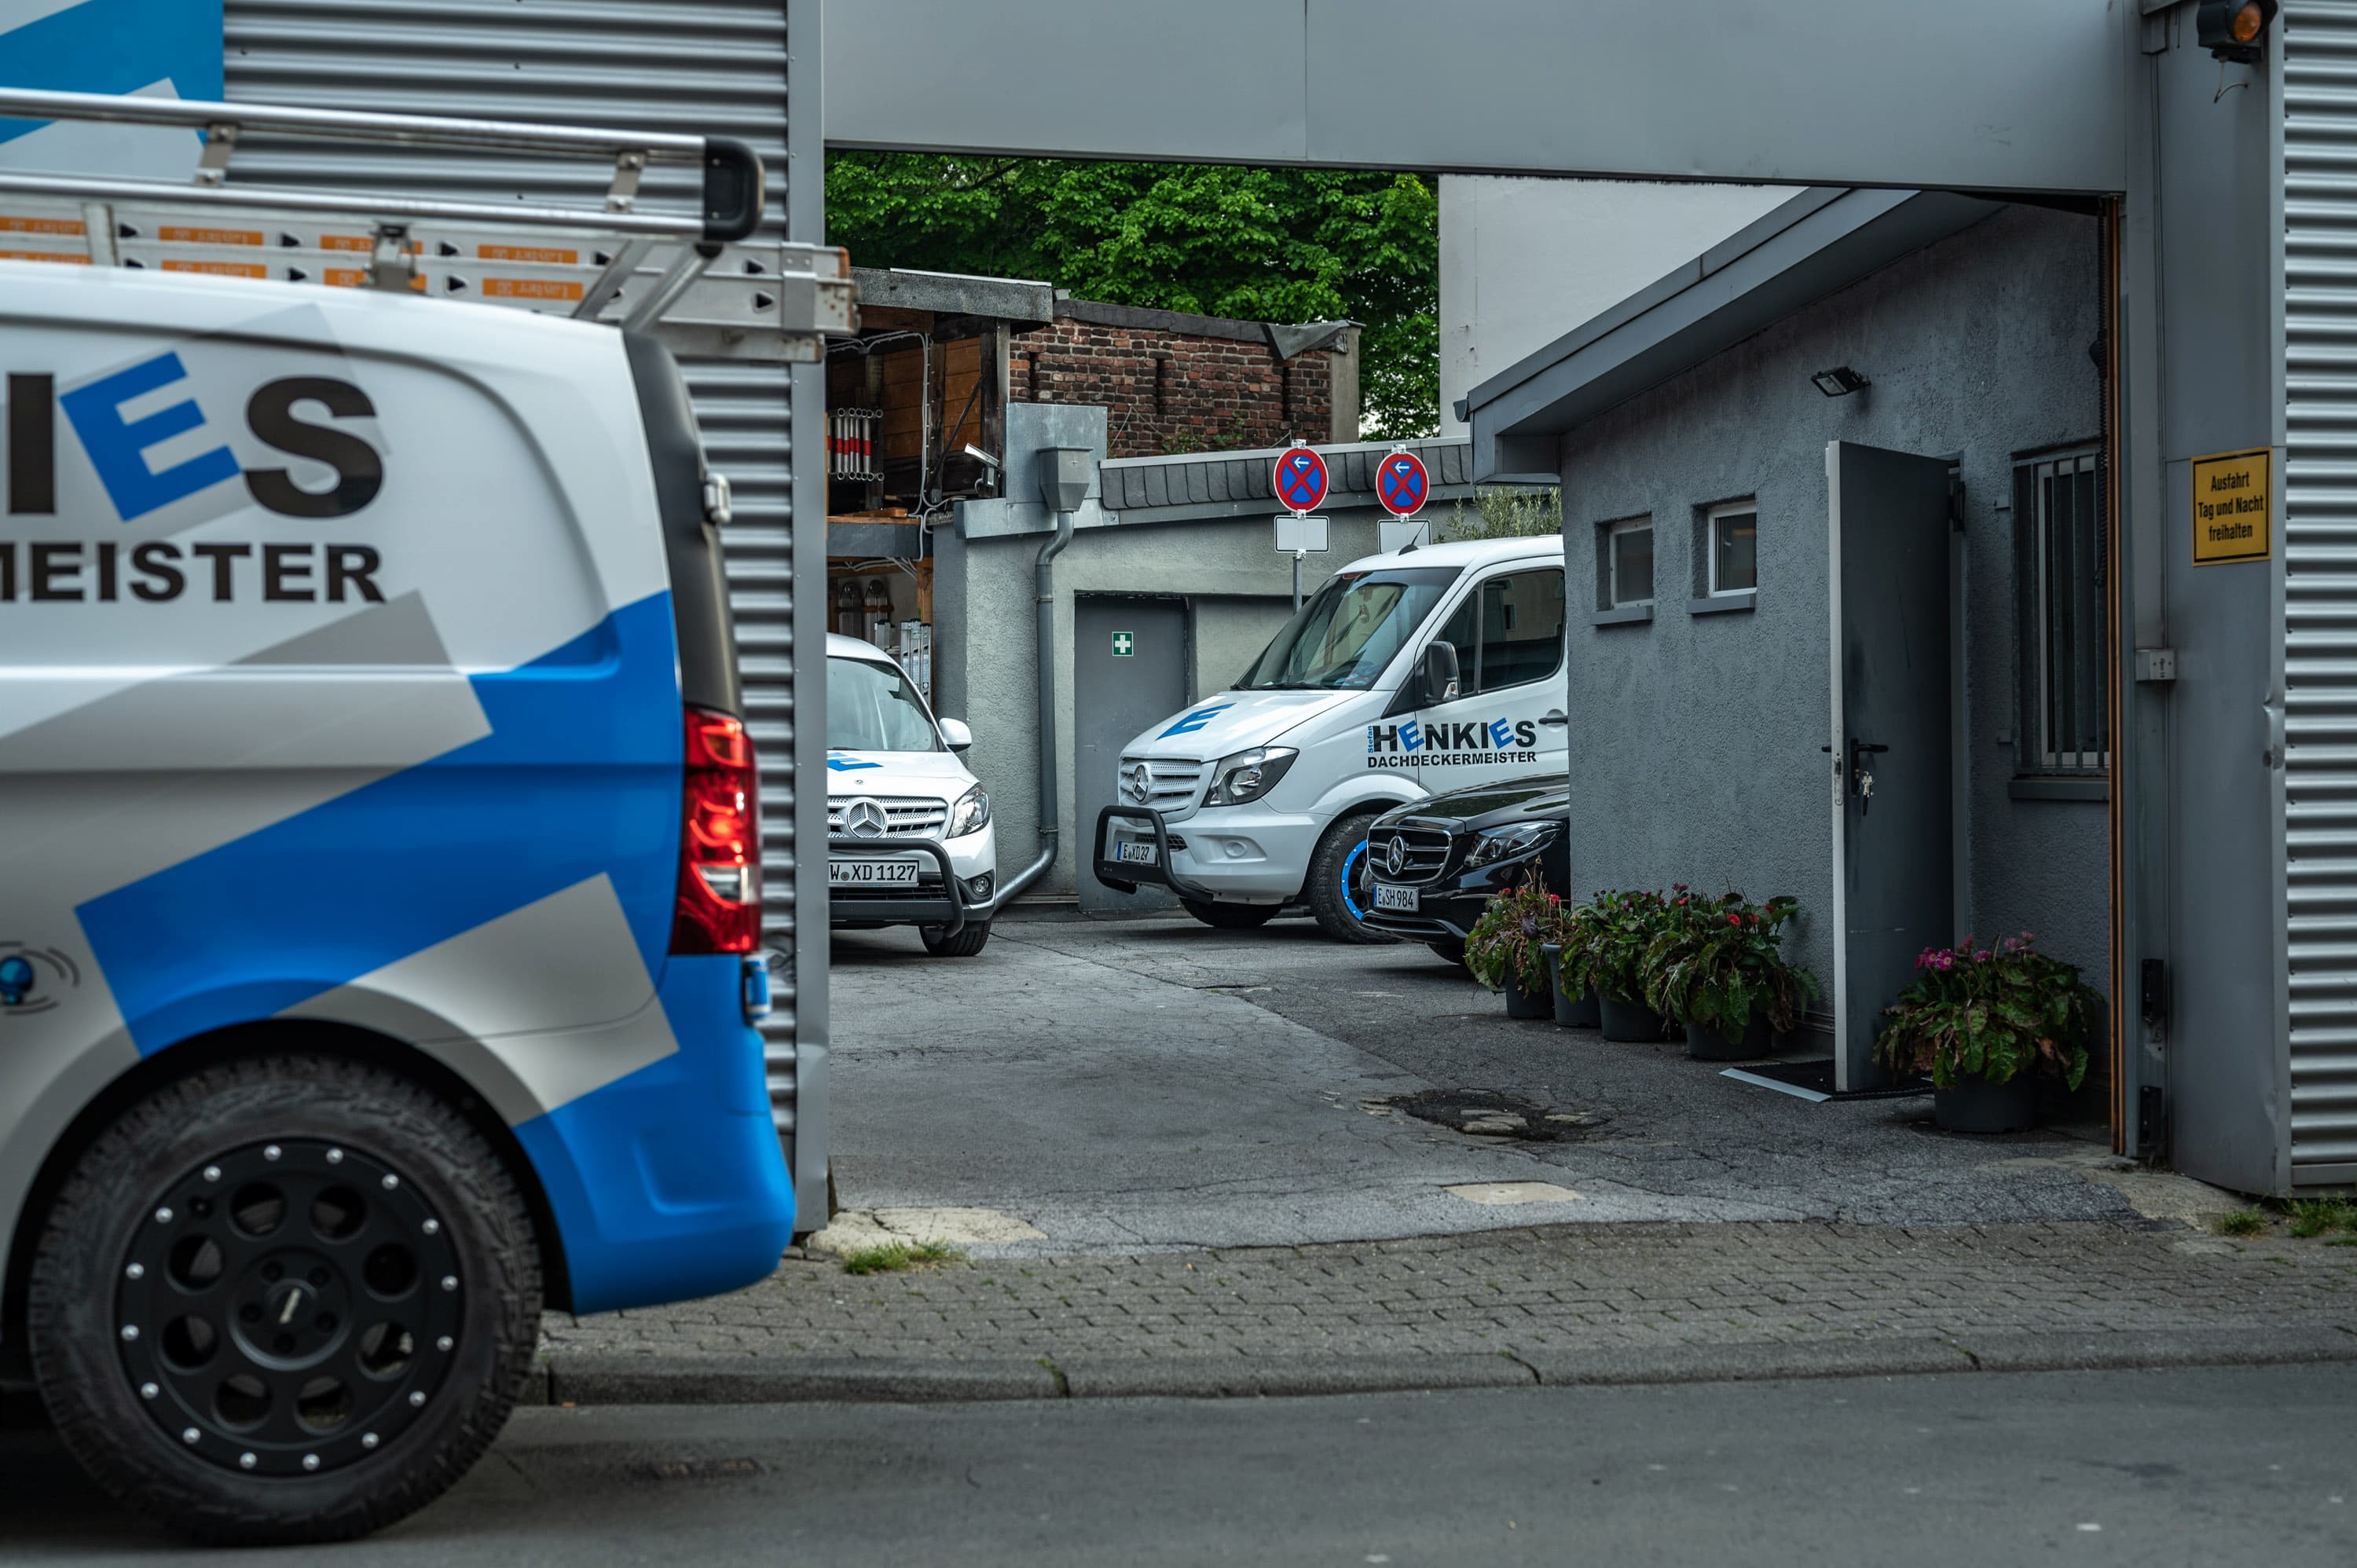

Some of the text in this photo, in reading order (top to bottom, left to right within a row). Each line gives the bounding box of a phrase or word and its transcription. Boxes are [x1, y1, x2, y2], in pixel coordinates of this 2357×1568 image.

[2211, 471, 2250, 492] Ausfahrt
[2198, 495, 2264, 520] Tag und Nacht
[2209, 523, 2253, 541] freihalten
[0, 542, 386, 603] EISTER
[1373, 717, 1537, 753] HENKIES
[1368, 752, 1537, 768] DACHDECKERMEISTER
[876, 864, 916, 881] 1127
